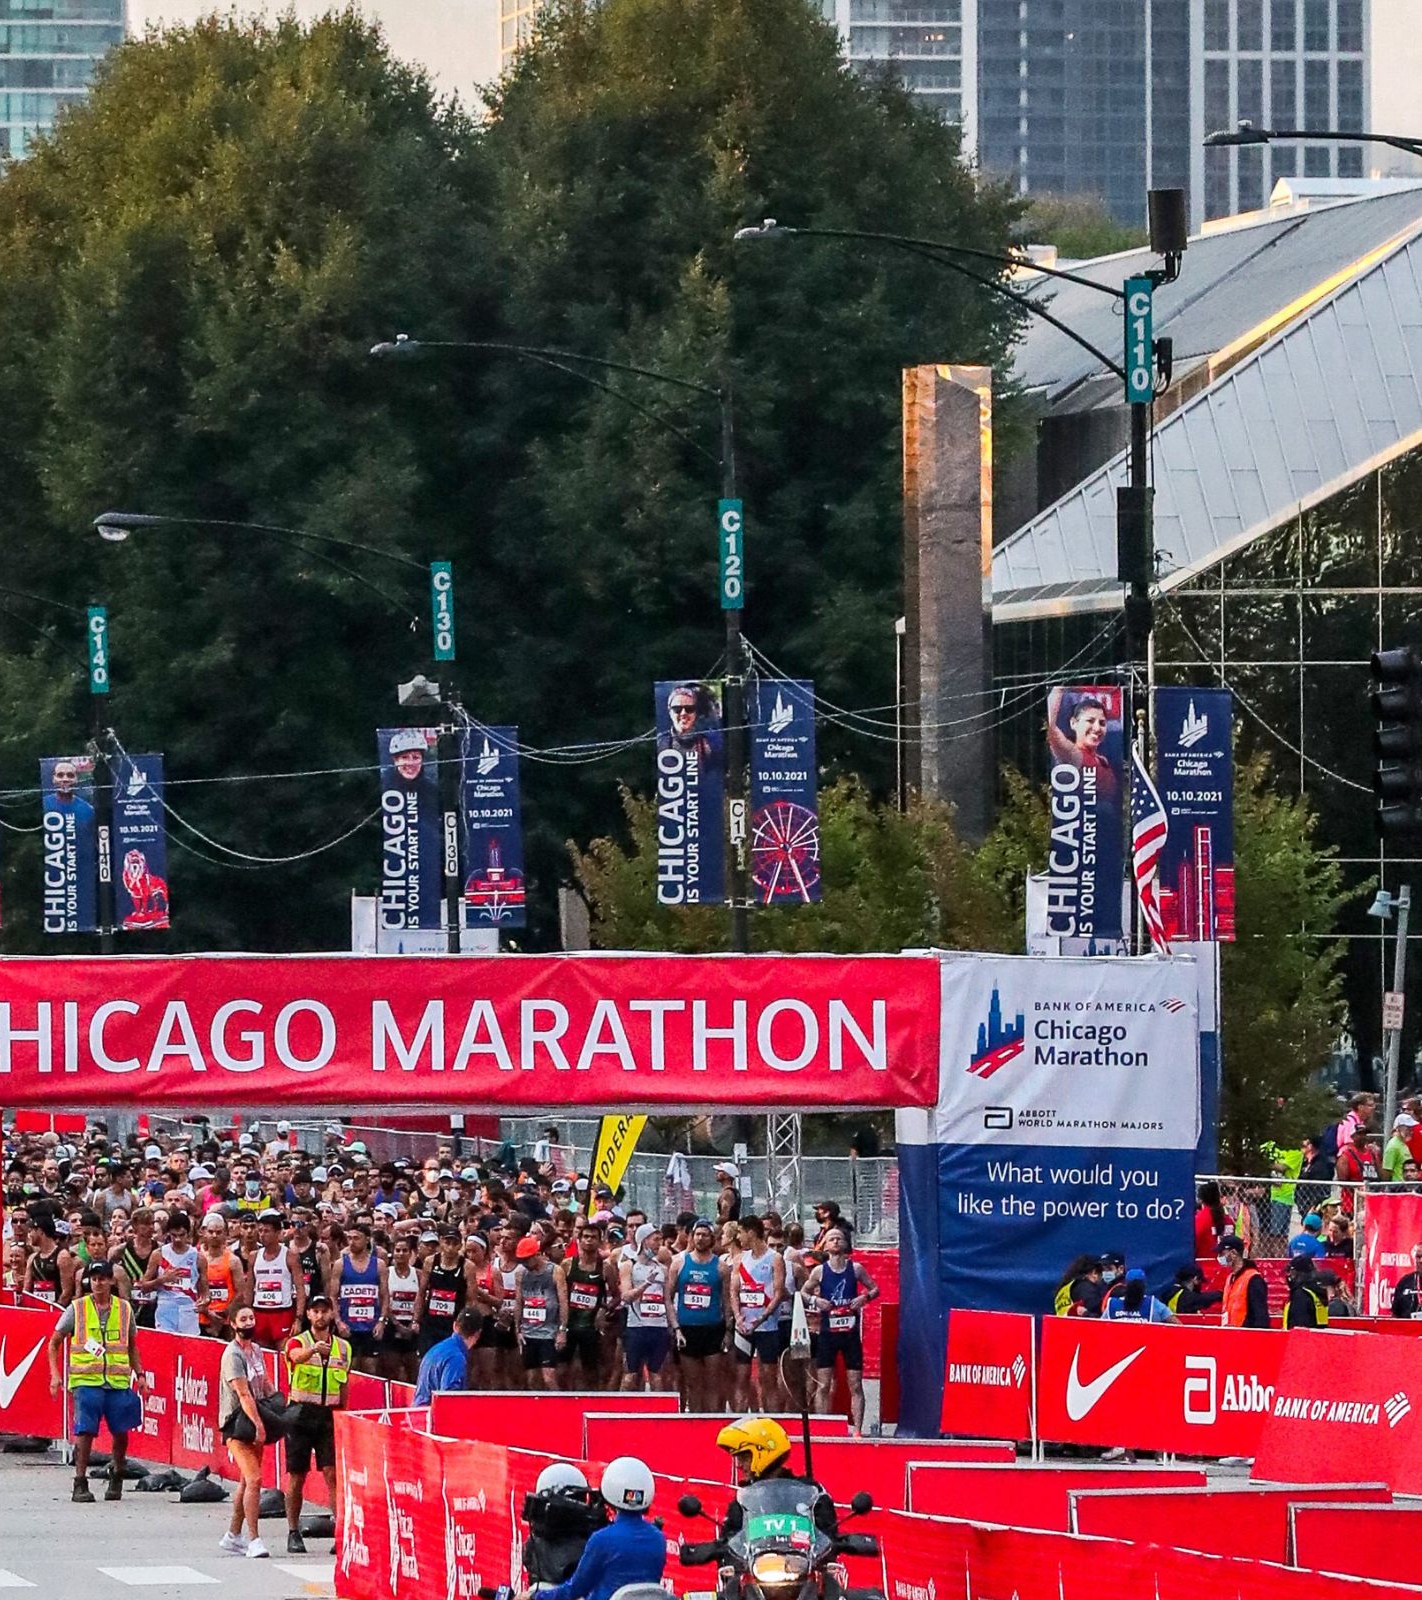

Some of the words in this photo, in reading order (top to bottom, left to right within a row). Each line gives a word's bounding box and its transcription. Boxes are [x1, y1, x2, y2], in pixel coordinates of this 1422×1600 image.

[1129, 291, 1150, 391] C110
[721, 510, 741, 598] C120
[433, 571, 452, 650] C130
[89, 616, 107, 684] C140
[686, 750, 700, 786] LINE
[758, 771, 807, 780] 10.10.2021
[1174, 768, 1212, 776] Marathon
[1177, 759, 1208, 770] Chicago
[1078, 766, 1097, 809] LINE
[1166, 791, 1223, 801] 10.10.2021
[407, 791, 420, 823] LINE
[468, 809, 513, 818] 10.10.2021
[686, 790, 700, 838] START
[67, 812, 77, 840] LINE
[119, 825, 158, 833] 10.10.2021
[657, 749, 684, 905] CHICAGO
[1078, 811, 1097, 865] START
[407, 826, 420, 870] START
[446, 813, 457, 874] C130
[1047, 764, 1079, 938] CHICAGO
[44, 811, 66, 934] CHICAGO
[67, 843, 77, 881] START
[382, 790, 406, 930] CHICAGO
[686, 842, 700, 885] YOUR
[67, 884, 77, 917] YOUR
[407, 874, 420, 912] YOUR
[686, 888, 700, 903] IS
[1078, 870, 1097, 917] YOUR
[67, 920, 77, 932] IS
[407, 915, 420, 929] IS
[1078, 922, 1097, 938] IS
[1034, 1002, 1071, 1011] BANK
[1076, 1002, 1092, 1011] OF
[1095, 1003, 1156, 1013] AMERICA
[372, 997, 887, 1073] MARATHON
[1034, 1020, 1127, 1045] Chicago
[1034, 1046, 1148, 1067] Marathon
[1018, 1119, 1053, 1128] WORLD
[1057, 1120, 1117, 1129] MARATHON
[1121, 1122, 1164, 1130] MAJORS
[1019, 1110, 1057, 1118] ABBOTT
[987, 1162, 1043, 1184] What
[1050, 1163, 1114, 1186] would
[1119, 1169, 1159, 1191] you
[958, 1193, 993, 1215] like
[1001, 1194, 1035, 1216] the
[1043, 1200, 1109, 1222] power
[1116, 1201, 1139, 1219] to
[1146, 1198, 1185, 1220] do?
[343, 1287, 376, 1296] CADETS
[184, 1366, 208, 1406] Advocate
[949, 1363, 972, 1383] BANK
[972, 1364, 981, 1384] OF
[981, 1365, 1011, 1386] AMERICA
[1274, 1396, 1311, 1418] BANK
[1310, 1400, 1327, 1420] OF
[1326, 1402, 1380, 1425] AMERICA
[183, 1413, 200, 1451] Health
[200, 1416, 214, 1453] Care
[763, 1519, 786, 1531] TV
[790, 1519, 797, 1531] 1
